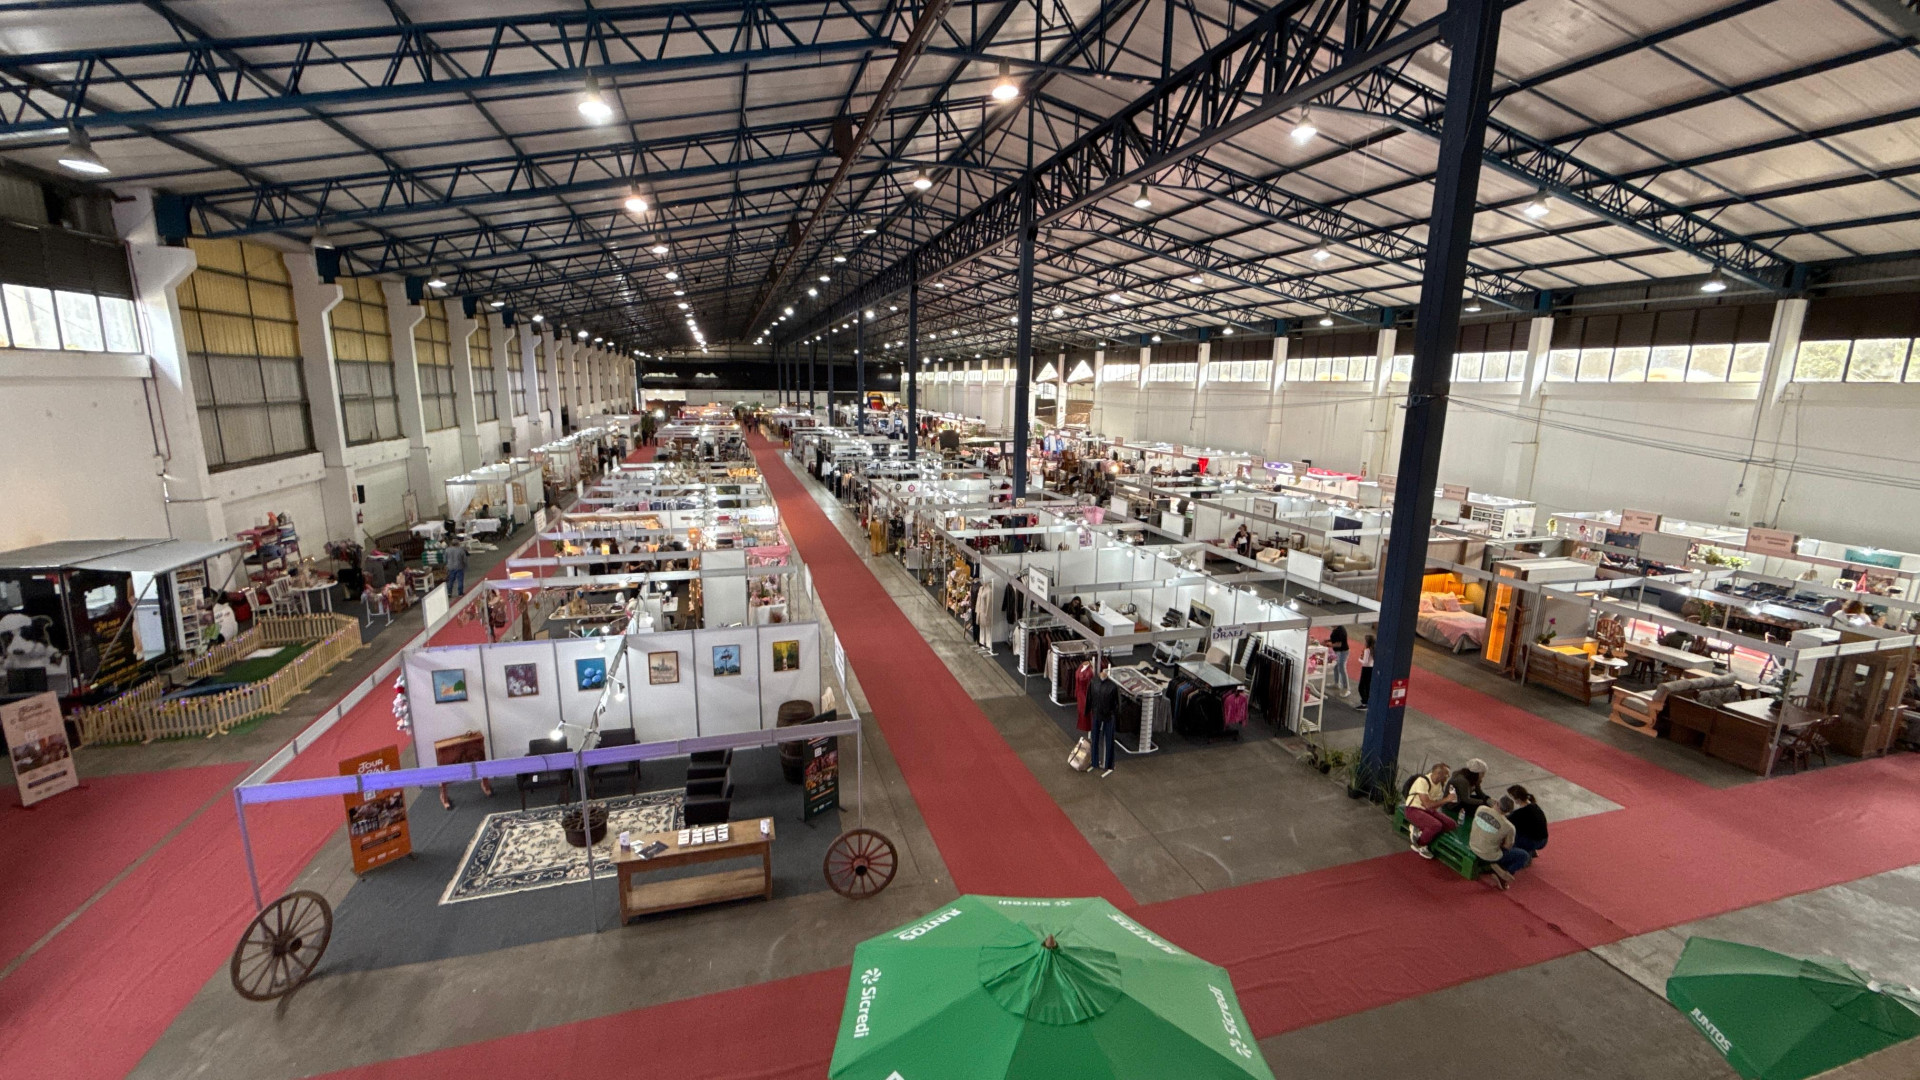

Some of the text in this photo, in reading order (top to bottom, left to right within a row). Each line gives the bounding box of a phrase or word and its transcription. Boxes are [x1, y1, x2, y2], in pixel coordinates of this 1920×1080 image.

[898, 907, 963, 941] JUNTOS
[1106, 913, 1178, 955] JUNTOS
[853, 986, 877, 1039] Sicredi
[1207, 983, 1242, 1039] Sicredi
[1690, 1007, 1733, 1051] JUNTOS
